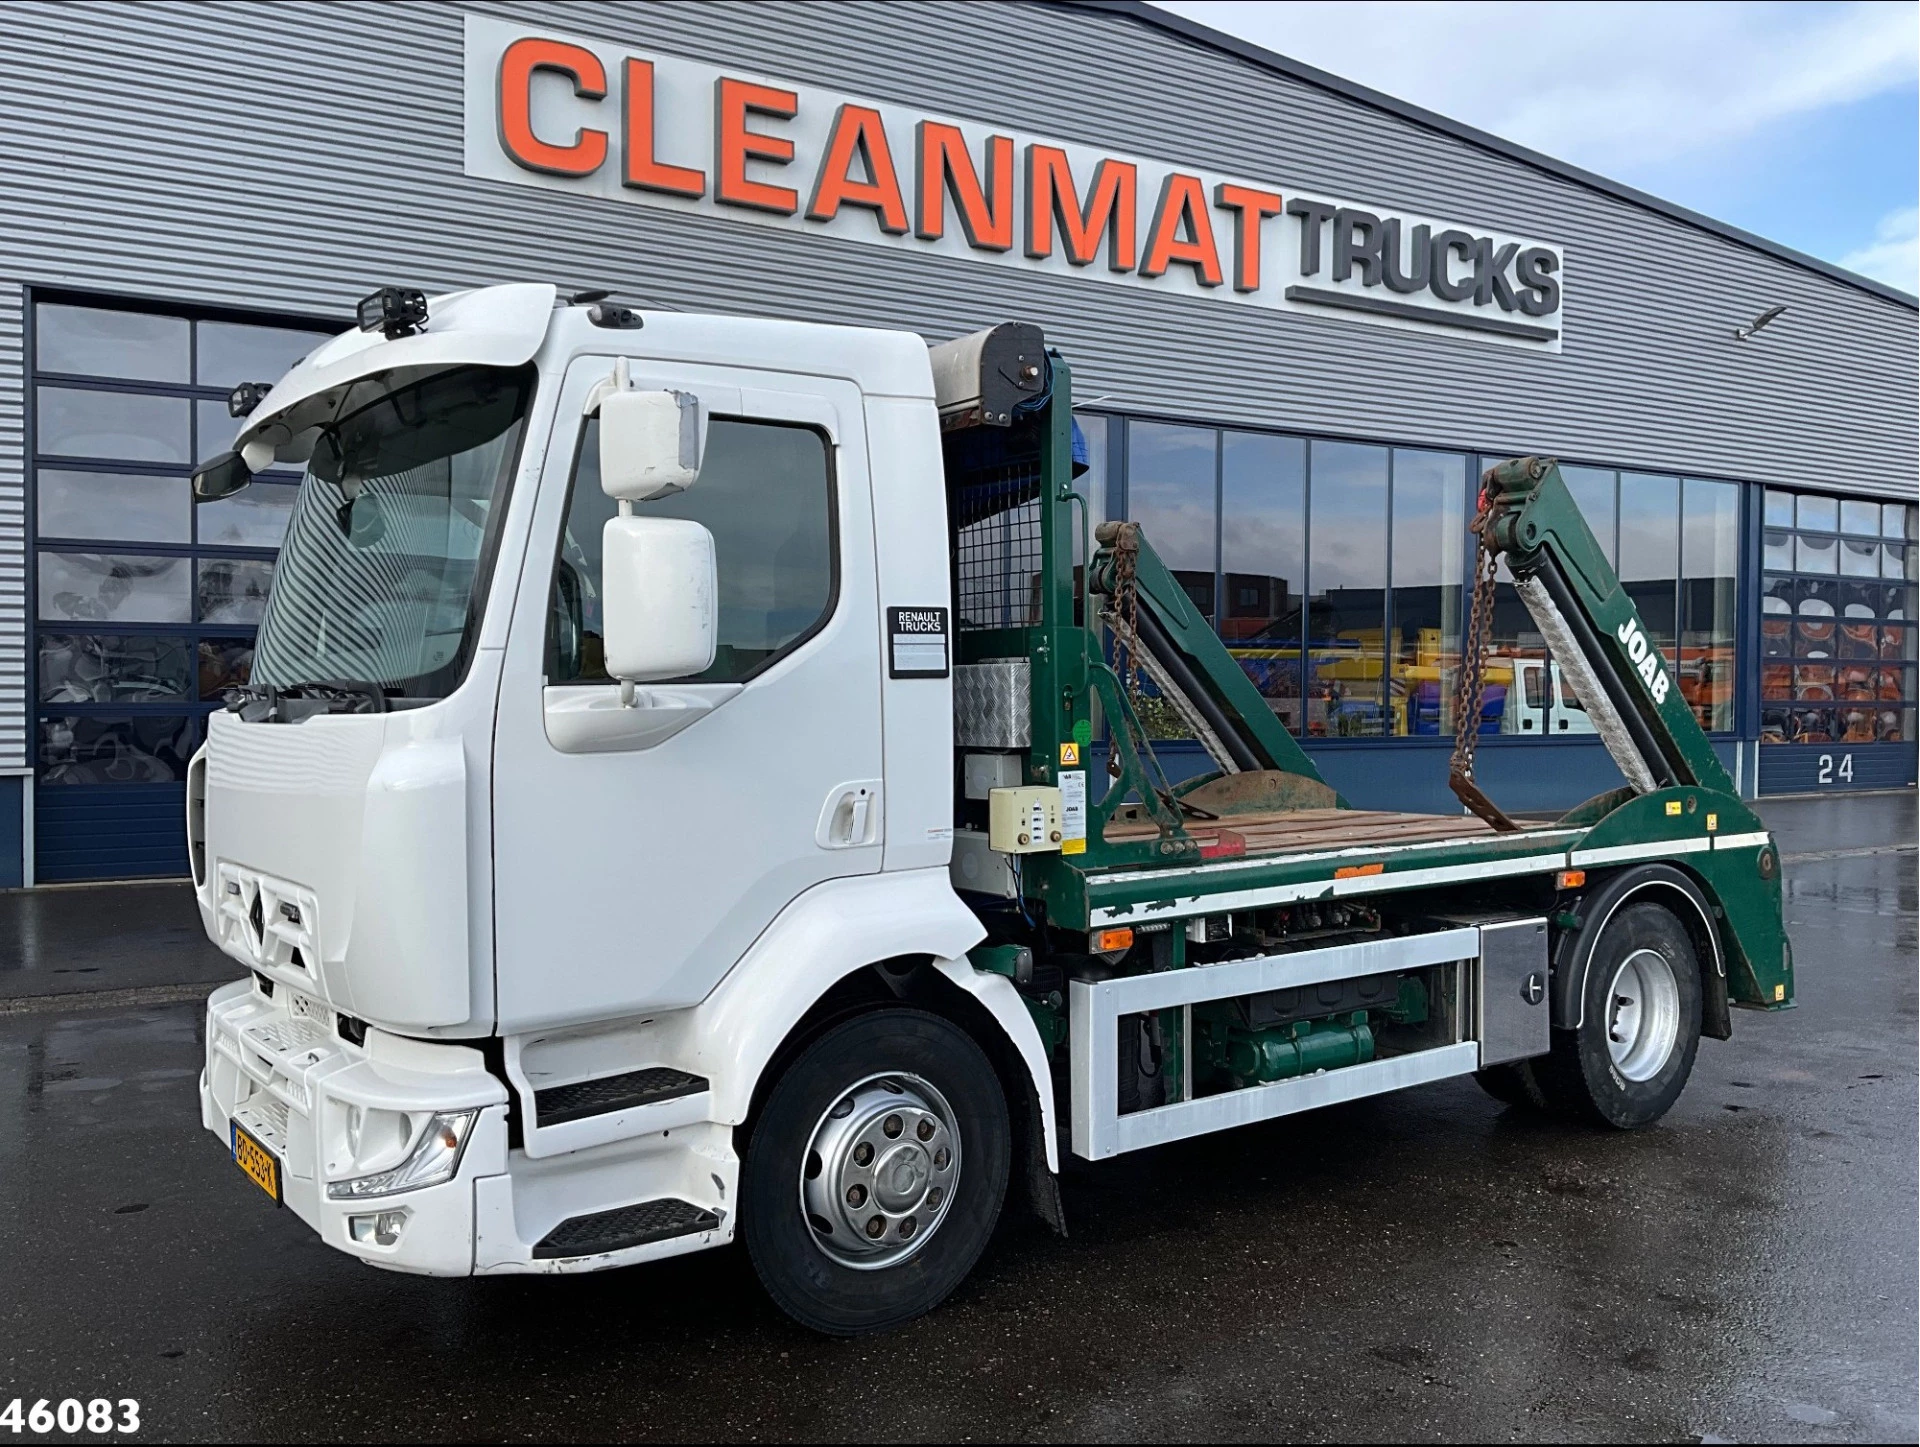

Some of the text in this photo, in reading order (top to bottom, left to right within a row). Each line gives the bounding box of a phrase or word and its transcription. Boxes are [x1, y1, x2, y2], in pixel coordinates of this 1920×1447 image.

[496, 36, 1560, 317] CLEANMAT TRUCKS
[898, 611, 941, 622] RENAULT
[898, 621, 941, 632] TRUCKS
[1617, 616, 1670, 705] JOAB
[1817, 753, 1854, 784] 24
